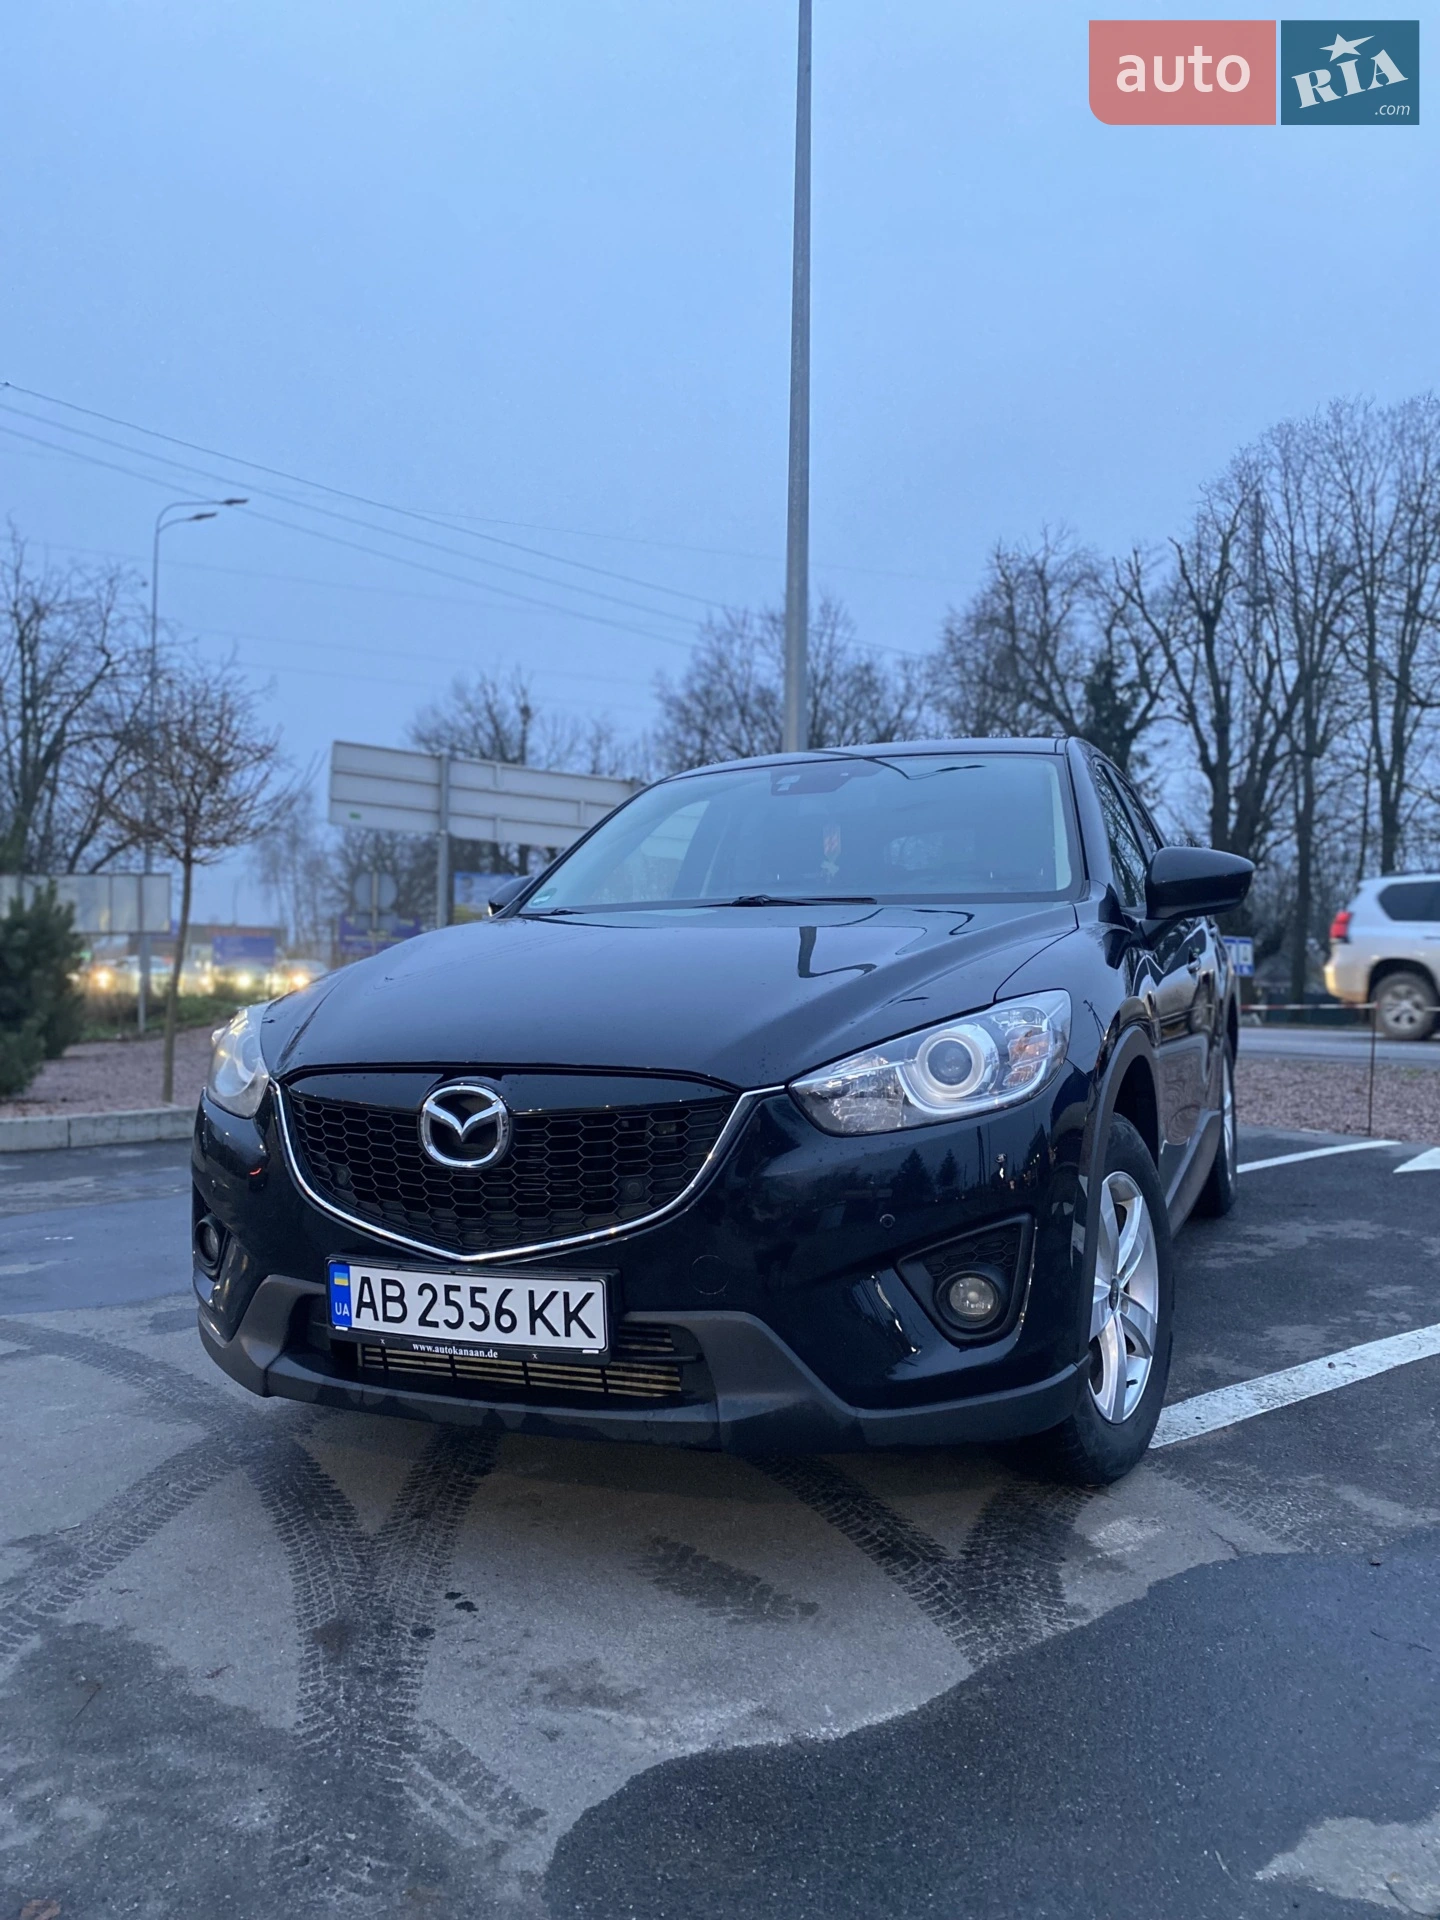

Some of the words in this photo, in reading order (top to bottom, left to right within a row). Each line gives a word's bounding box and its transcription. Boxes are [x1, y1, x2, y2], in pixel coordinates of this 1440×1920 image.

[335, 1302, 350, 1317] UA
[355, 1276, 408, 1323] AB
[417, 1283, 518, 1334] 2556
[528, 1289, 597, 1339] KK
[412, 1342, 499, 1359] www.autokanaan.de
